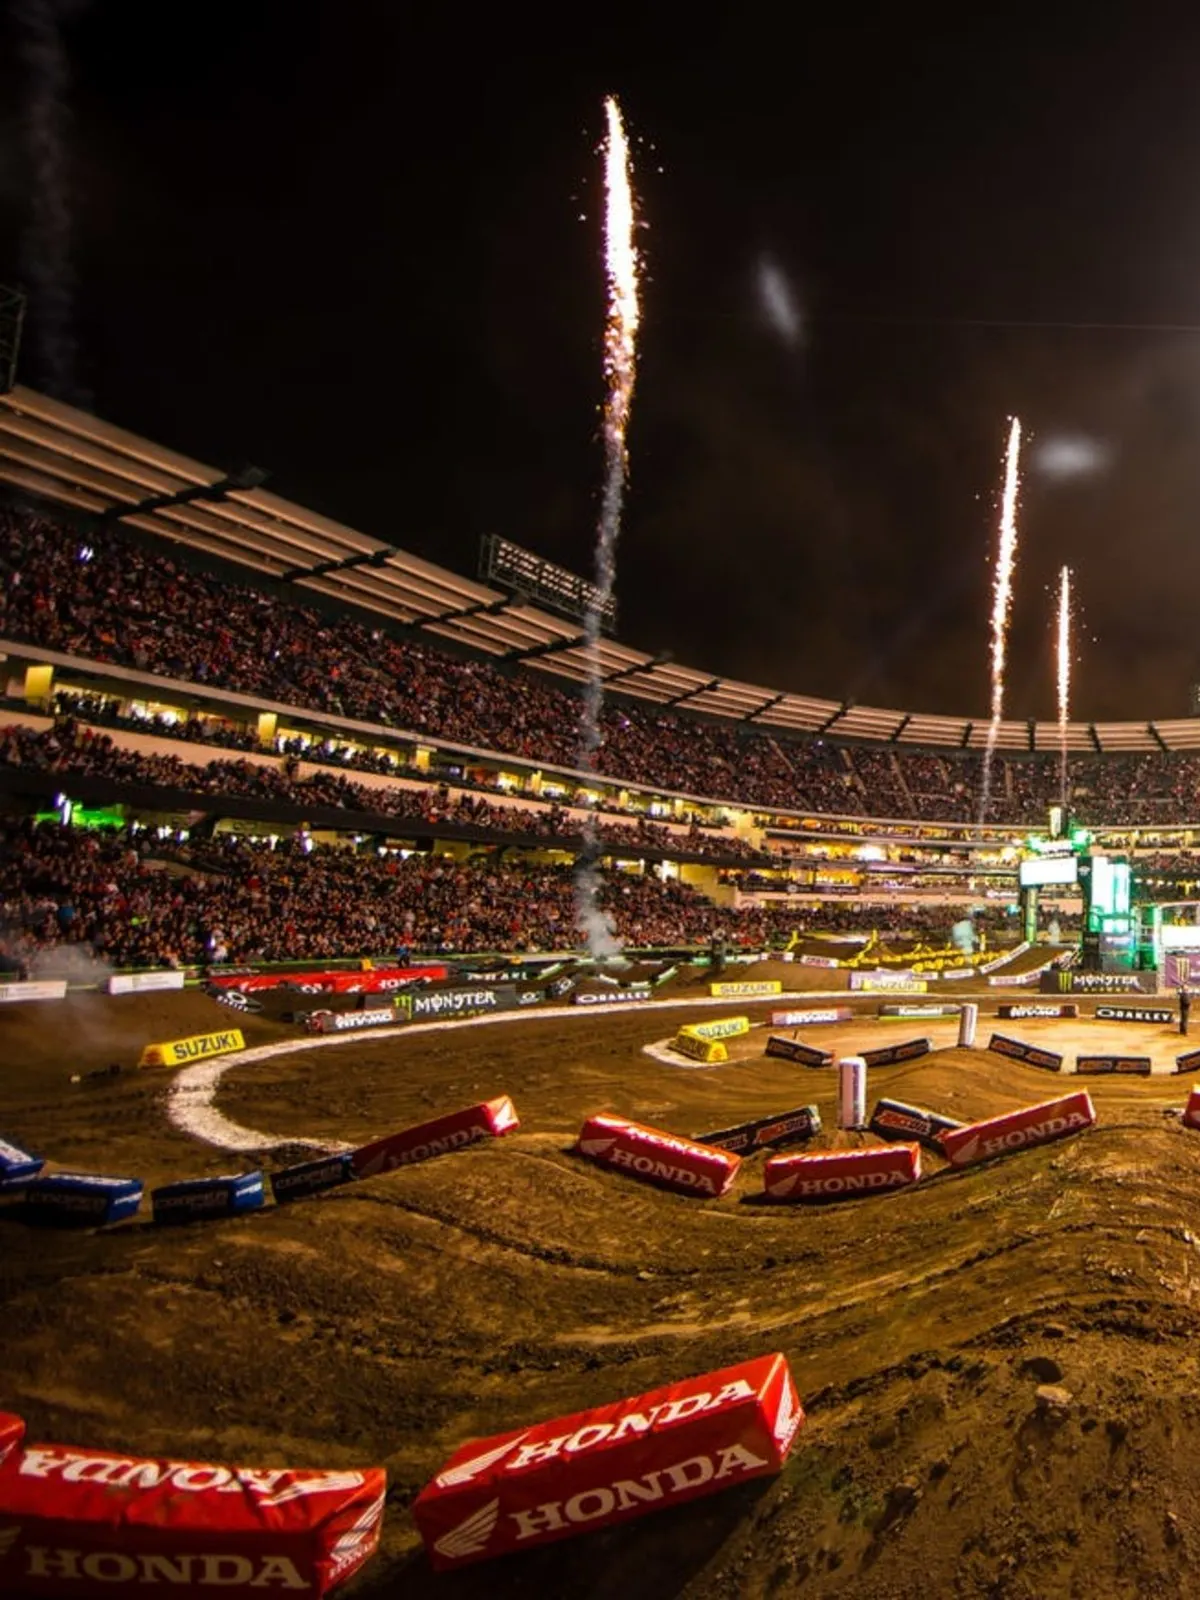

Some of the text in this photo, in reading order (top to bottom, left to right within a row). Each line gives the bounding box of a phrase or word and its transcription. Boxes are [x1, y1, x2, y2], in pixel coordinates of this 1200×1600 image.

[720, 983, 775, 994] SUZUKI
[1073, 974, 1141, 988] MONSTER
[415, 991, 497, 1013] MONSTER
[1116, 1010, 1171, 1021] OAKLEY
[173, 1033, 239, 1060] SUZUKI
[697, 1021, 745, 1038] SUZUKI
[388, 1124, 491, 1171] HONDA
[982, 1110, 1091, 1153] HONDA
[610, 1147, 717, 1194] HONDA
[801, 1170, 910, 1195] HONDA
[506, 1379, 758, 1469] HONDA
[19, 1450, 292, 1494] HONDA
[508, 1444, 769, 1540] HONDA
[24, 1547, 311, 1590] HONDA
